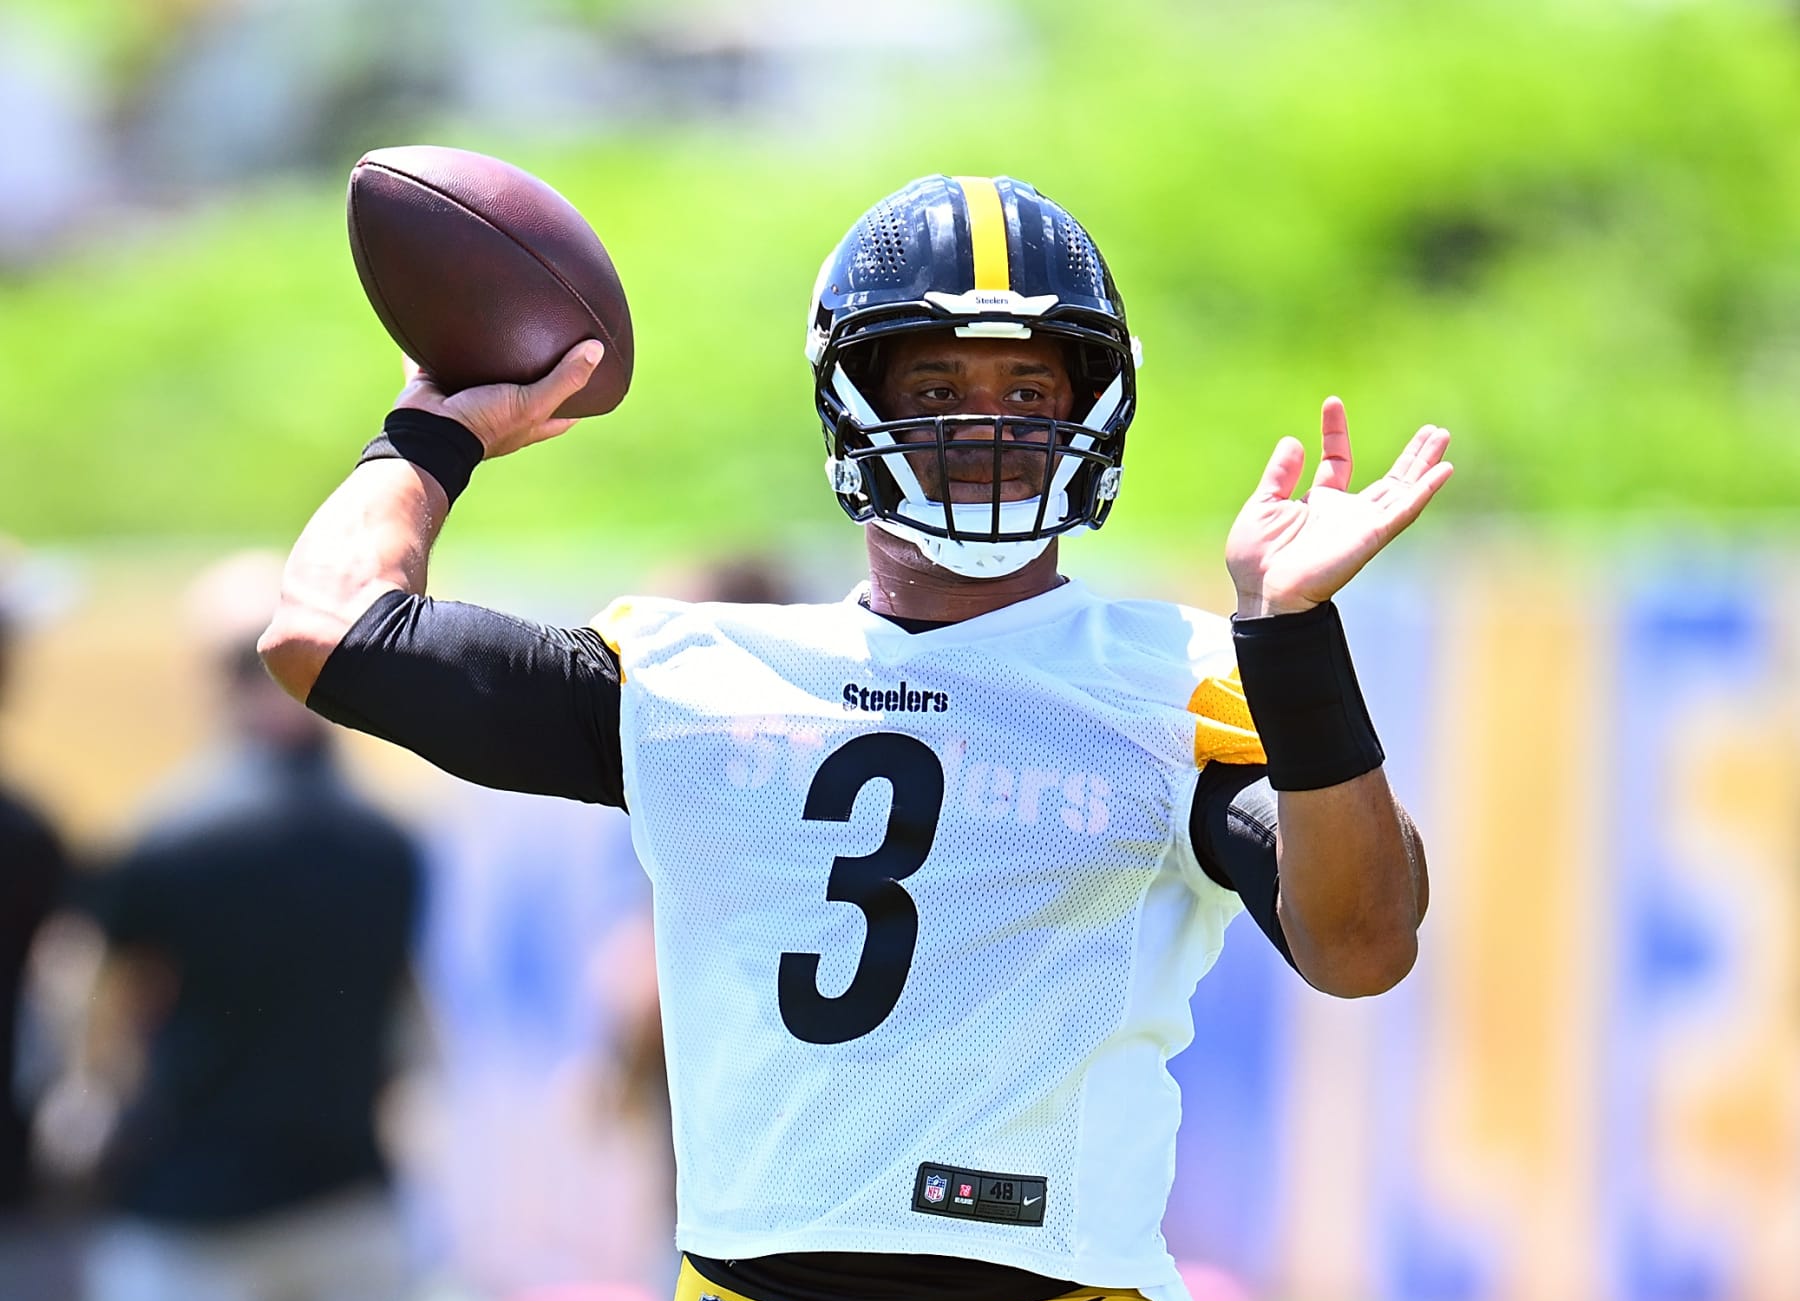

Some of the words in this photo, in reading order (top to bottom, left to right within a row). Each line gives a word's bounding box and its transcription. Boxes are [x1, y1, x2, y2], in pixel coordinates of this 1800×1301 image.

[975, 296, 1008, 304] Steelers
[842, 681, 949, 713] Steelers
[778, 733, 944, 1044] 3
[928, 1187, 941, 1199] NFL
[990, 1182, 1013, 1200] 48
